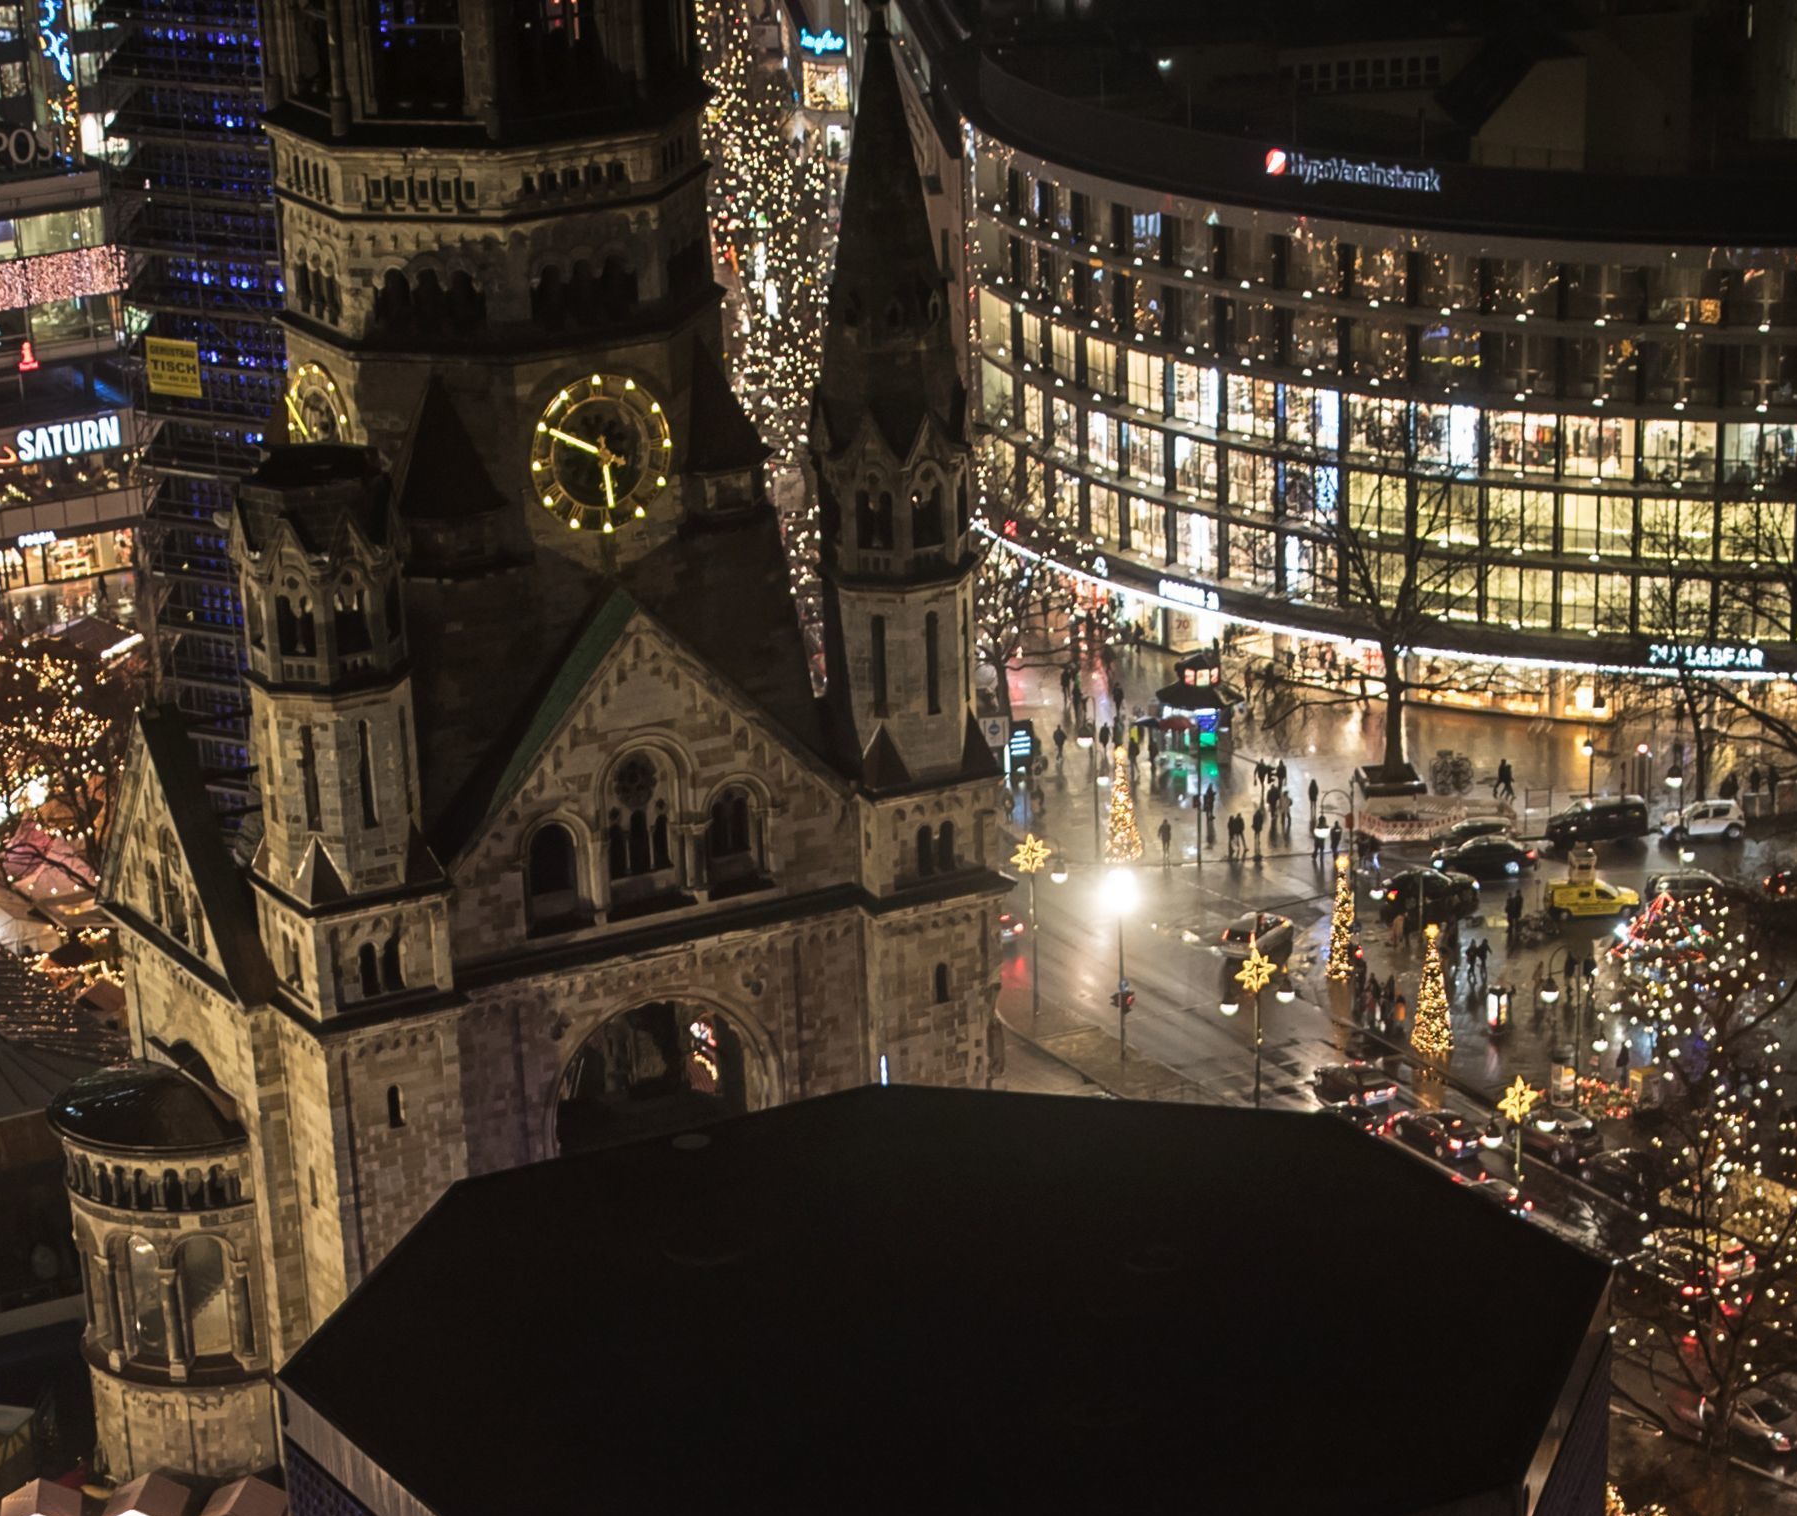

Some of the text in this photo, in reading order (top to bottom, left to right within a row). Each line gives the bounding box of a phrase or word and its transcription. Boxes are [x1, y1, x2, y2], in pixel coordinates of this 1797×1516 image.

[1290, 152, 1441, 192] HypoVereinsbank
[150, 359, 197, 375] TISCH
[15, 415, 121, 462] SATURN
